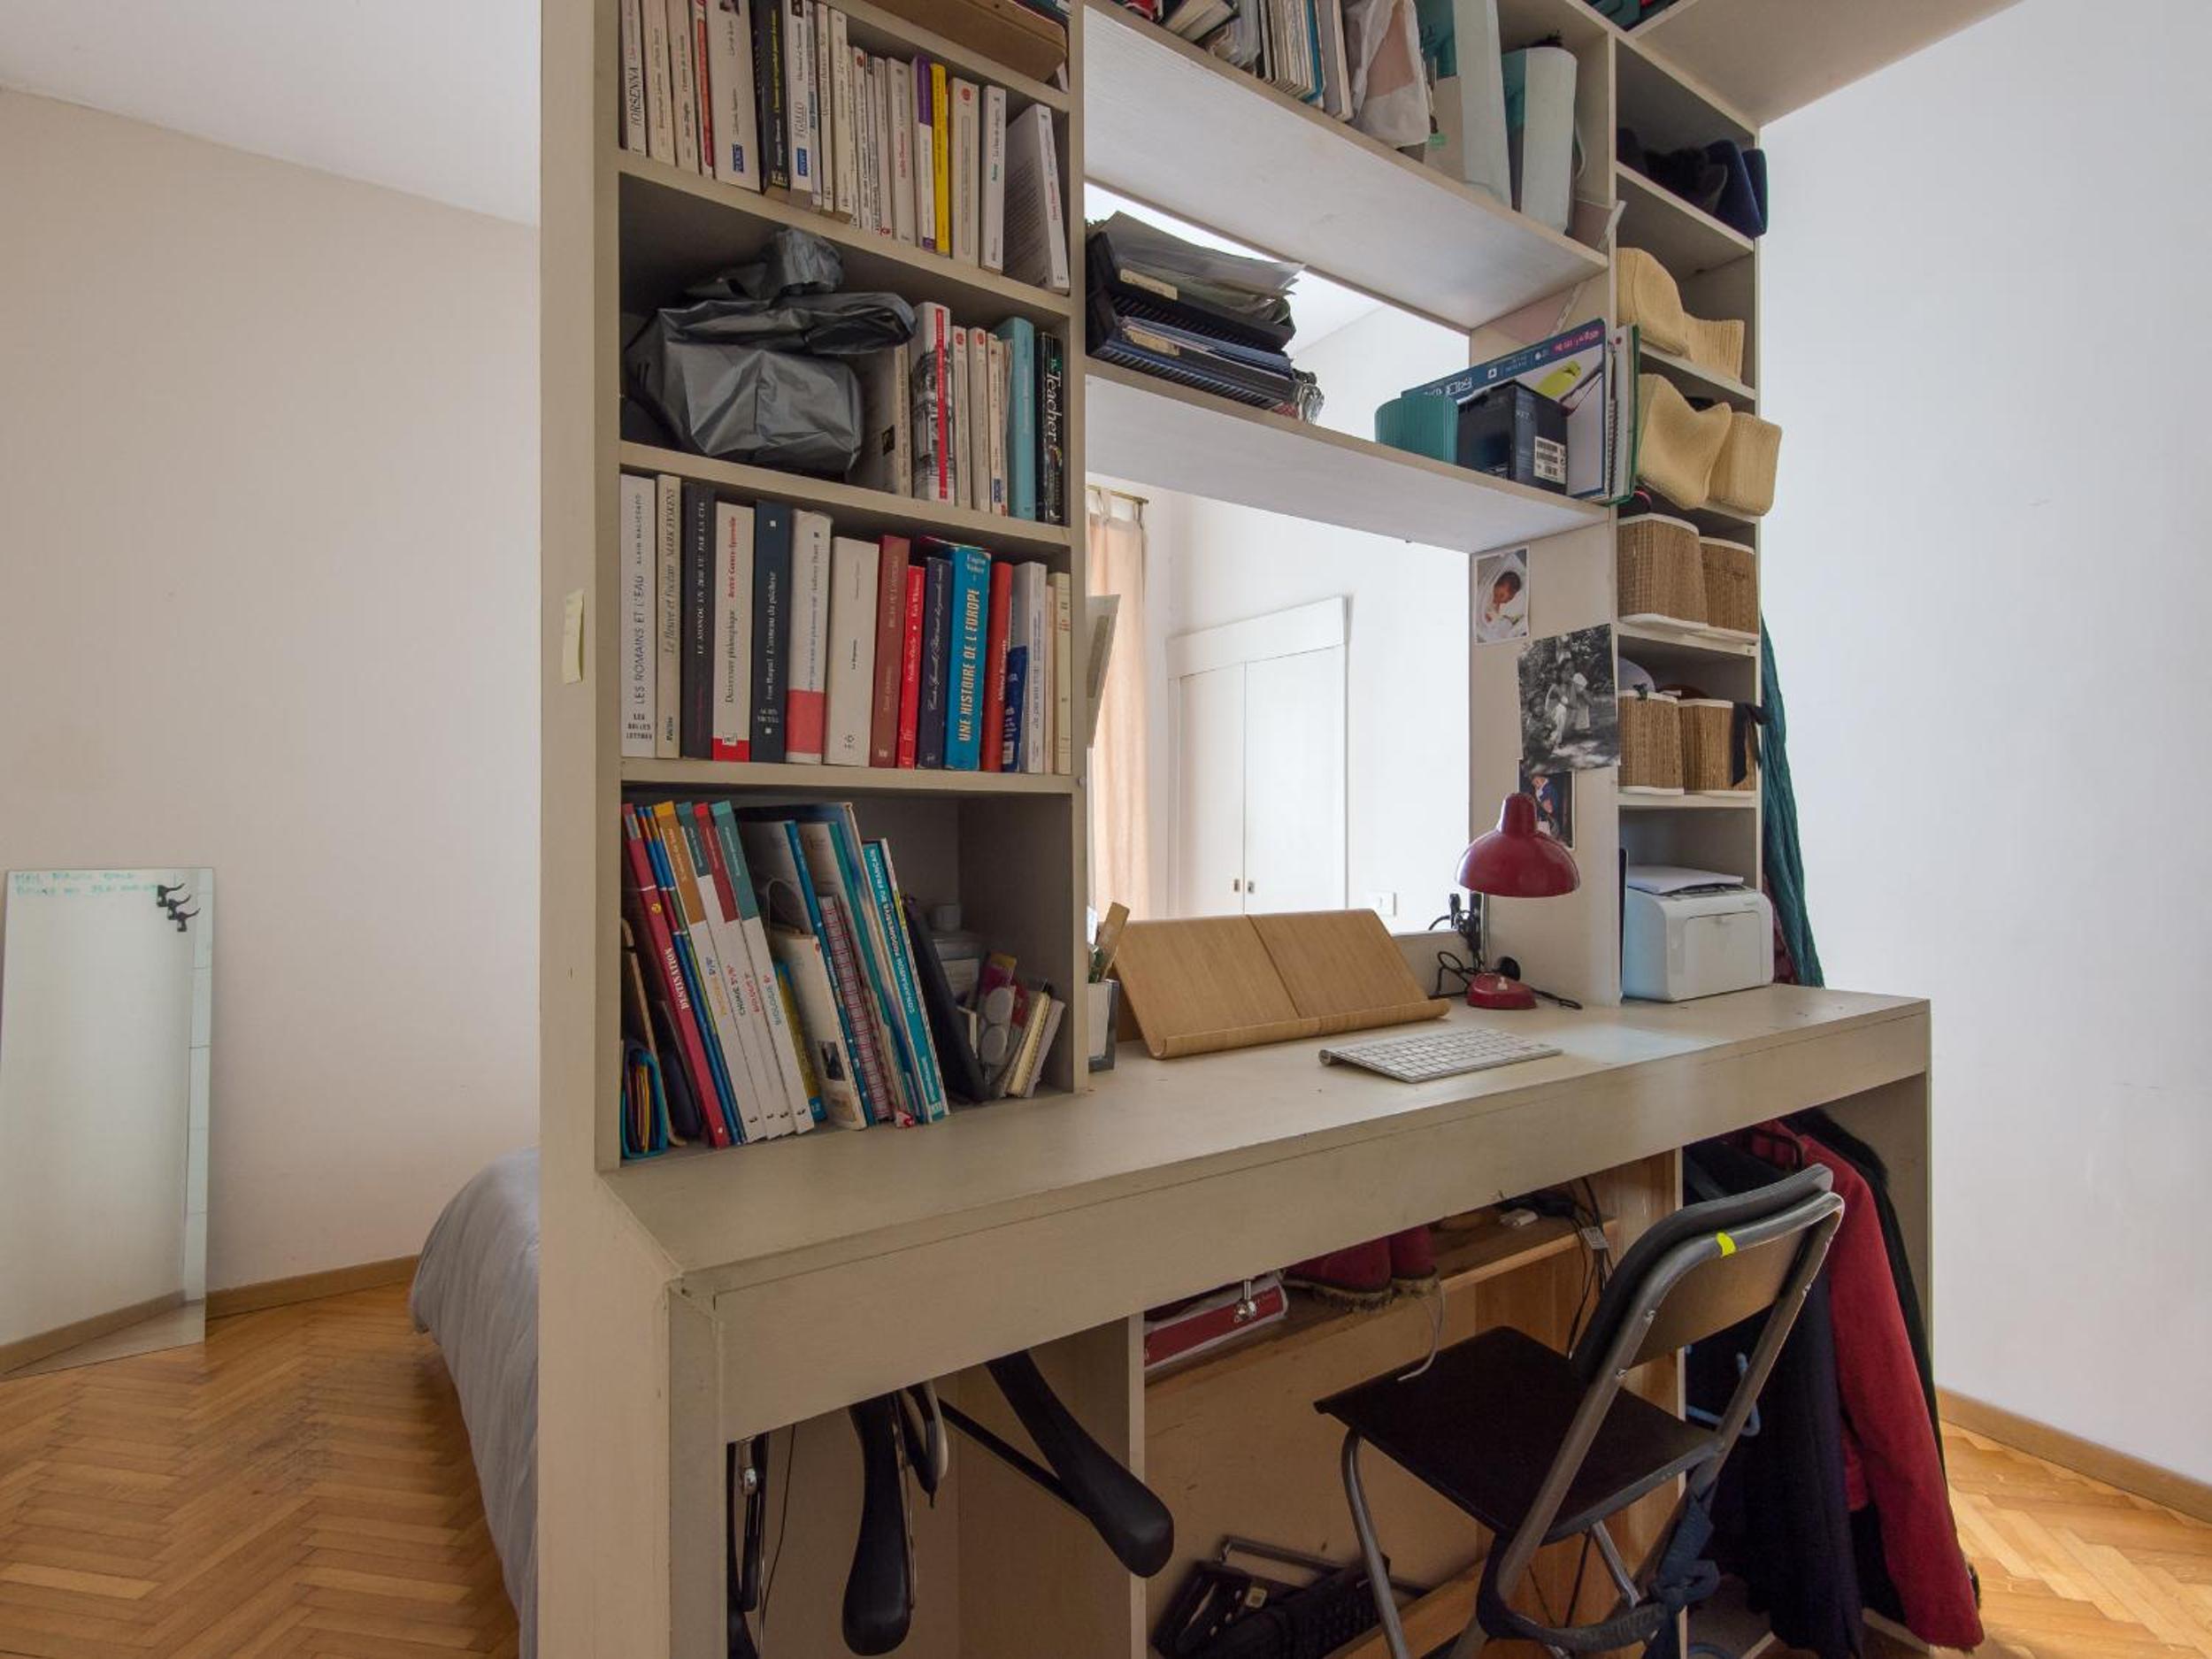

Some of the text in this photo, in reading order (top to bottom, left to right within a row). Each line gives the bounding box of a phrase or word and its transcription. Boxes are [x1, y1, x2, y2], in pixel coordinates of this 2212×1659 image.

[1046, 371, 1063, 442] Teacher
[633, 611, 644, 624] ET
[633, 627, 645, 681] ROMAINS
[963, 644, 977, 659] DE
[634, 685, 645, 704] LES
[960, 664, 976, 715] HISTOIRE
[958, 718, 972, 741] UNE
